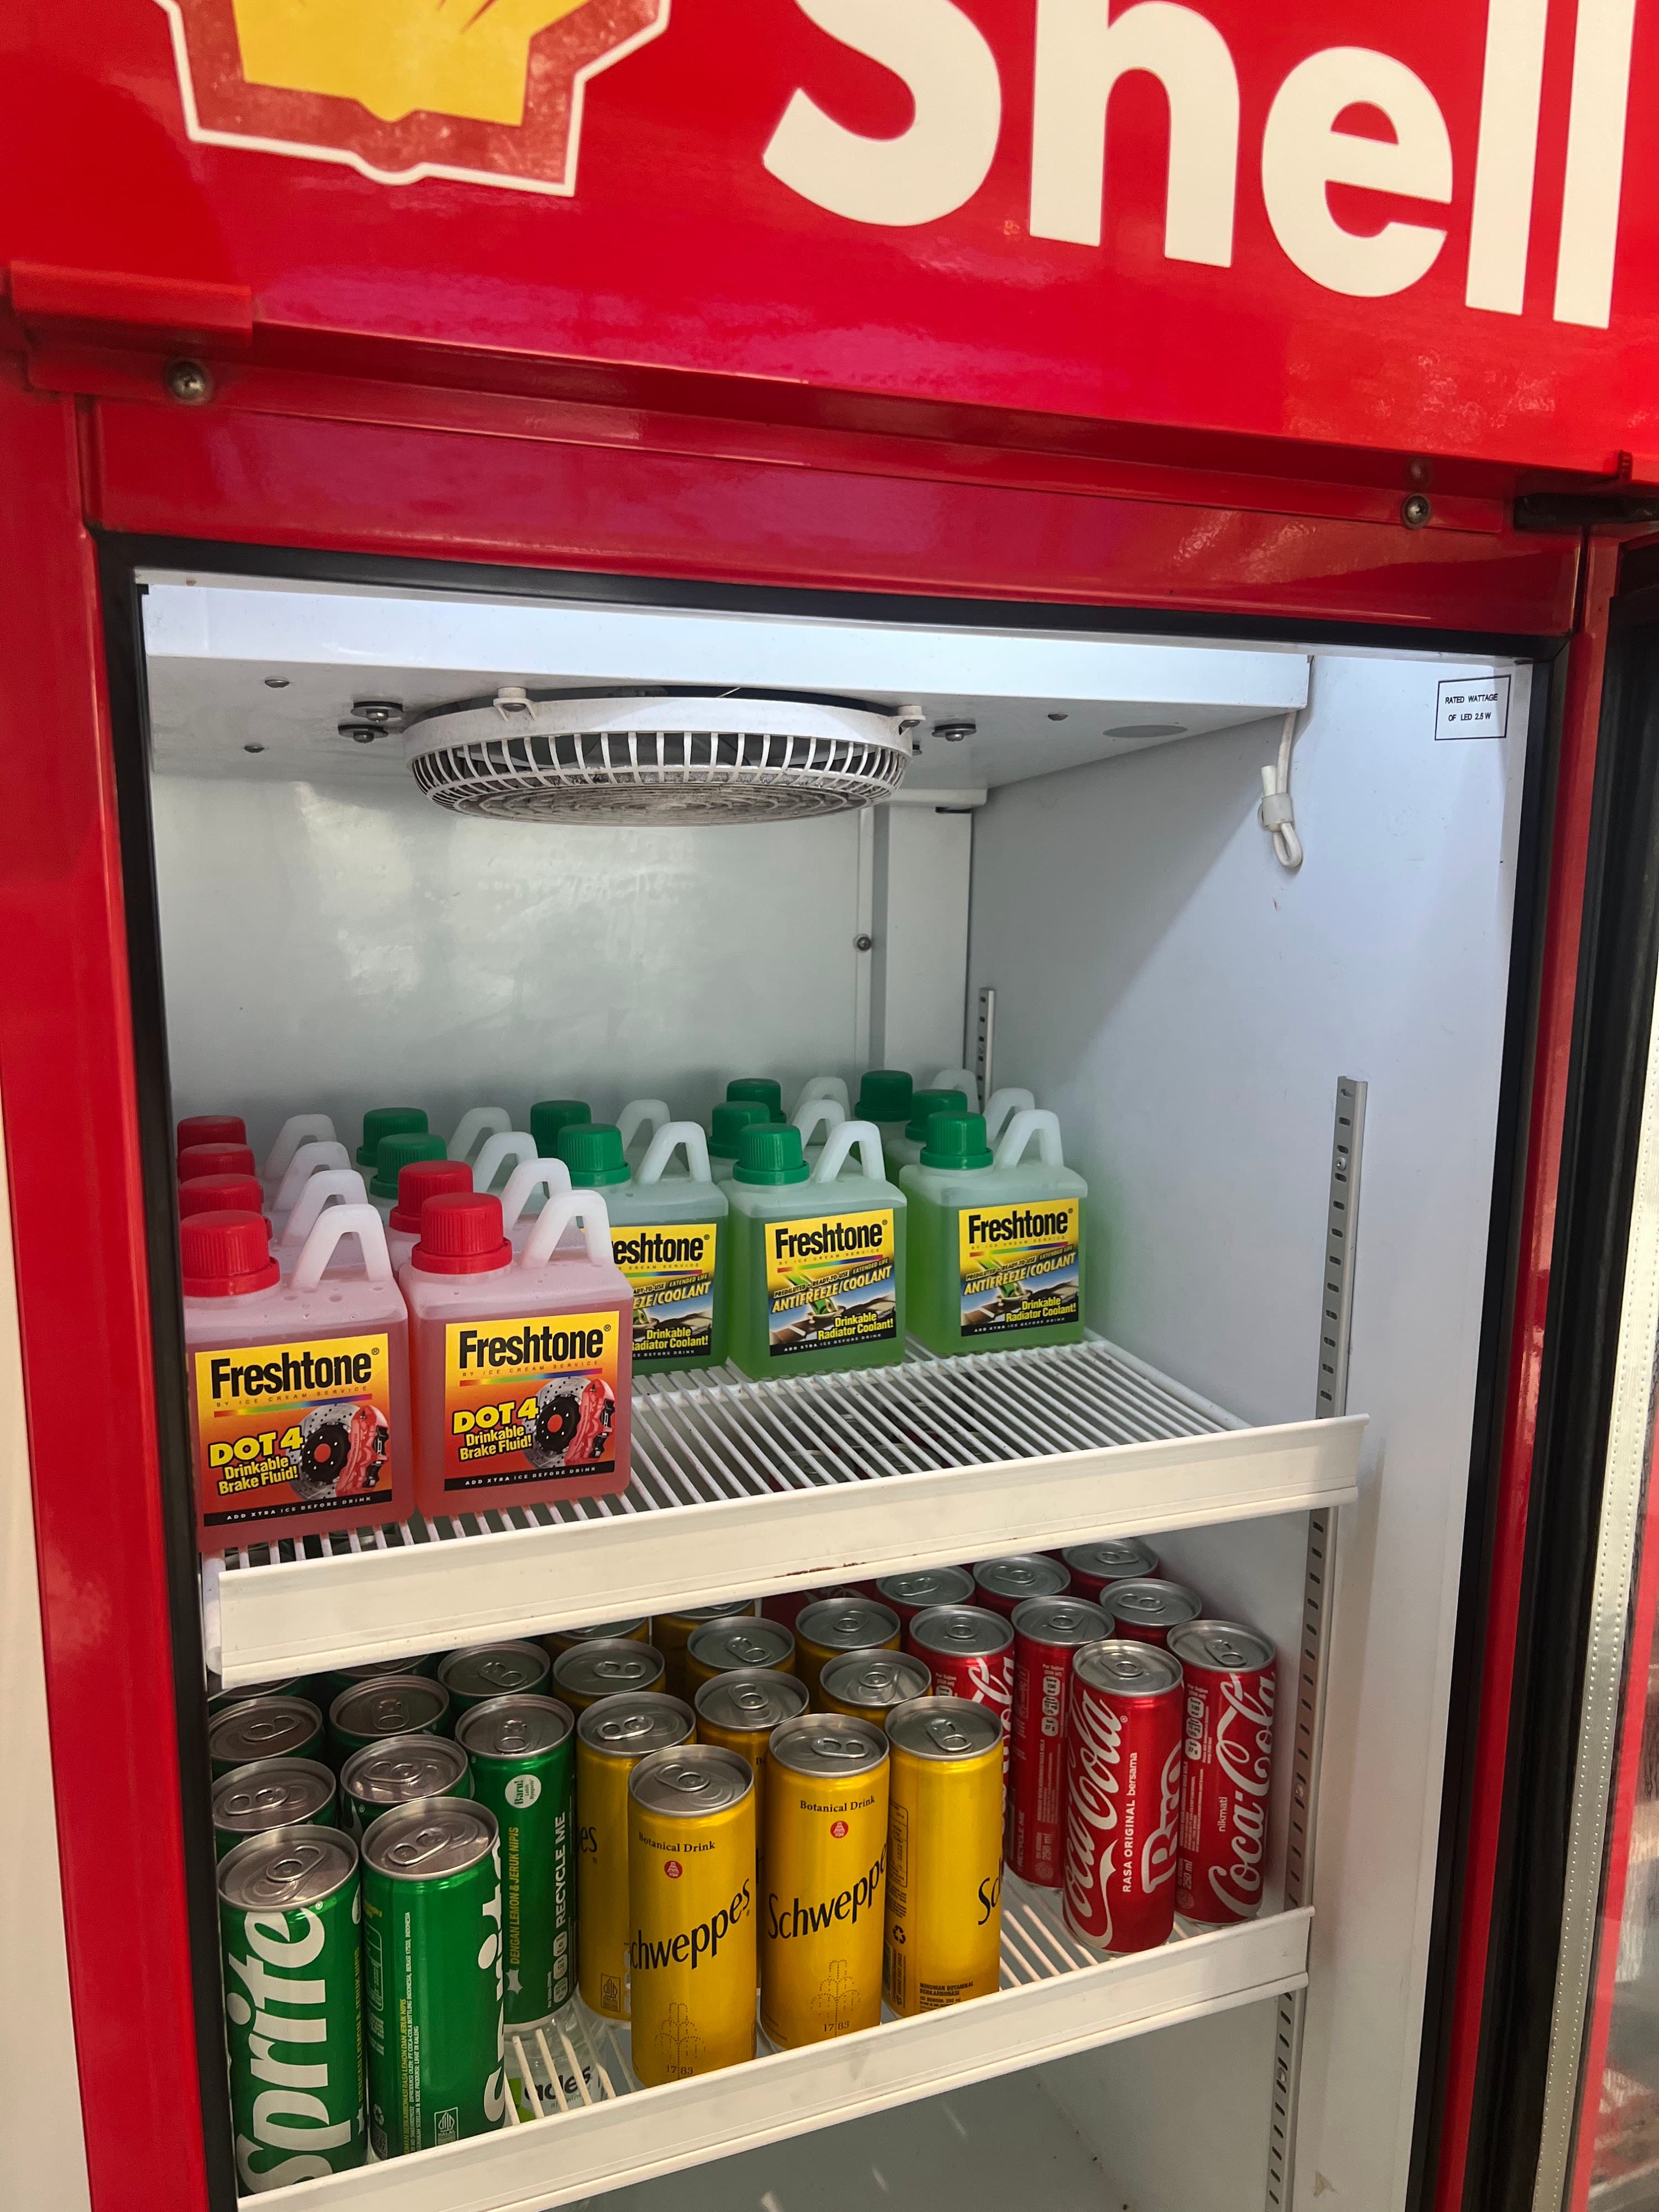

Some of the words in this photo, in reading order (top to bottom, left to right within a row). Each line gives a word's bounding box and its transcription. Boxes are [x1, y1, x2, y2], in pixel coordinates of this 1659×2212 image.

[763, 0, 1635, 329] Shell
[1468, 693, 1498, 702] WATTAGE
[775, 1223, 883, 1259] Freshtone
[969, 1211, 1068, 1244] Freshtone
[612, 1233, 703, 1264] eshtone
[1040, 1248, 1062, 1260] EXTENDED
[1063, 1245, 1073, 1254] LIFE
[634, 1284, 665, 1294] ADY-TO-USE
[669, 1276, 696, 1287] EXTENDED
[772, 1265, 892, 1313] ANTIFREEZE/COOLANT
[775, 1284, 806, 1297] PREDILUTED
[812, 1271, 848, 1287] READY-TO-USE
[853, 1262, 878, 1274] EXTENDED
[879, 1258, 889, 1267] LIFE
[964, 1253, 1076, 1296] ANTIFREEZE/COOLANT
[634, 1282, 711, 1309] EZE/COOLANT
[1022, 1296, 1061, 1310] Drinkable
[834, 1312, 877, 1327] Drinkable
[1005, 1310, 1041, 1322] Radiator
[1042, 1303, 1076, 1317] Coolant!
[647, 1327, 691, 1339] Drinkable
[669, 1335, 708, 1348] Coolant!
[818, 1328, 856, 1340] Radiator
[857, 1318, 894, 1334] Coolant!
[460, 1326, 603, 1369] Freshtone
[211, 1352, 372, 1400] Freshtone
[553, 1360, 598, 1369] SERVICE
[269, 1393, 307, 1402] CREAM
[317, 1386, 367, 1396] SERVICE
[453, 1402, 515, 1434] DOT
[518, 1397, 539, 1420] 4
[210, 1432, 276, 1467] DOT
[280, 1427, 304, 1449] 4
[460, 1443, 497, 1461] Brake
[498, 1434, 533, 1453] Fluid!
[466, 1425, 525, 1447] Drinkable
[219, 1475, 259, 1495] Brake
[262, 1465, 299, 1486] Fluid!
[225, 1455, 289, 1480] Drinkable
[533, 1469, 565, 1478] BEFORE
[301, 1501, 337, 1510] BEFORE
[342, 1496, 372, 1504] DRINK
[1126, 1752, 1138, 1796] bersama
[800, 1800, 847, 1812] Botanical
[850, 1795, 875, 1811] Drink
[1208, 1673, 1275, 1917] Coca-Cola
[509, 1827, 519, 1851] NIPIS
[555, 1812, 566, 1844] ME
[639, 1832, 680, 1852] Botanical
[684, 1841, 716, 1853] Drink
[1124, 1799, 1135, 1858] ORIGINAL
[509, 1853, 519, 1883] JERUK
[1123, 1861, 1133, 1893] RASA
[1185, 1859, 1193, 1872] ml
[555, 1844, 566, 1929] RECYCLE
[768, 1843, 887, 1940] Schweppe
[509, 1892, 520, 1925] LEMON
[630, 1878, 750, 1970] chweppes
[510, 1925, 520, 1964] DENGAN
[226, 1907, 351, 2194] Sprite
